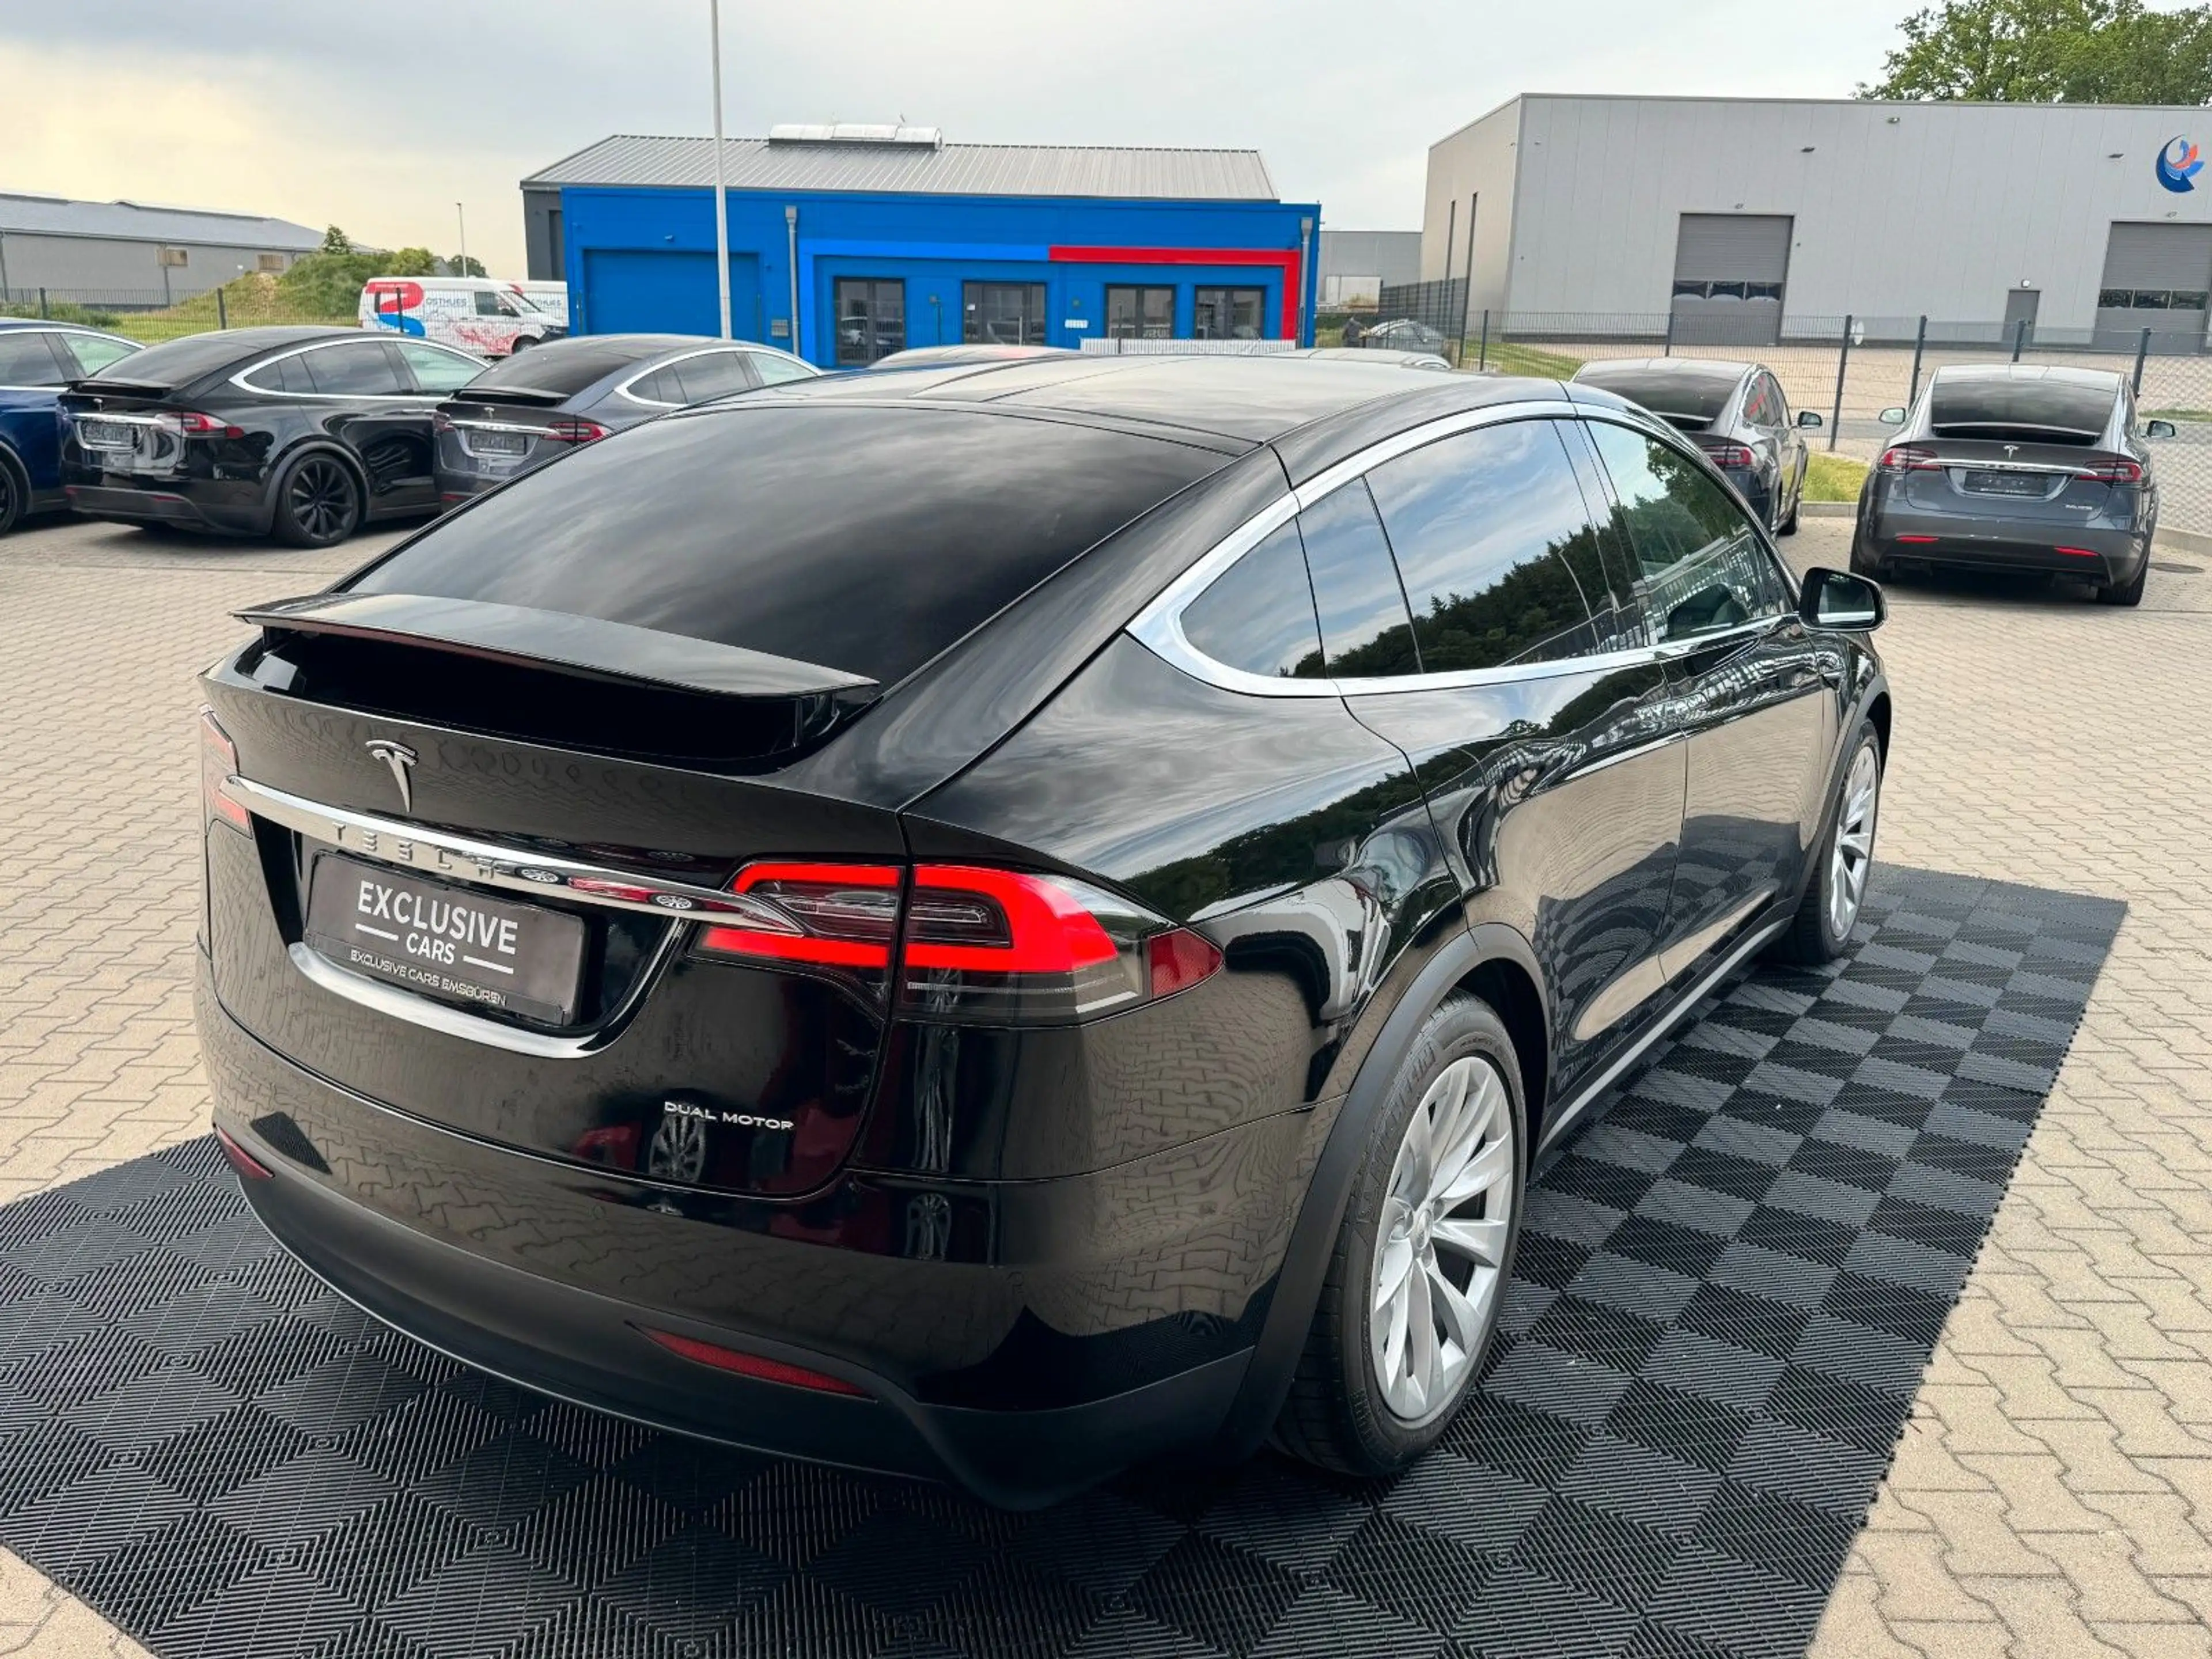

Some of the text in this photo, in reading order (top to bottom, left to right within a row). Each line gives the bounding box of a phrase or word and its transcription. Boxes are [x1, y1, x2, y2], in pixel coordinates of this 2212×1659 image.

[332, 821, 494, 878] TESLA
[358, 880, 518, 955] EXCLUSIVE
[406, 933, 456, 964] CARS
[350, 949, 506, 1007] EXCLUSIVE CARS EMSBÜREN
[664, 1101, 794, 1131] DUAL MOTOR
